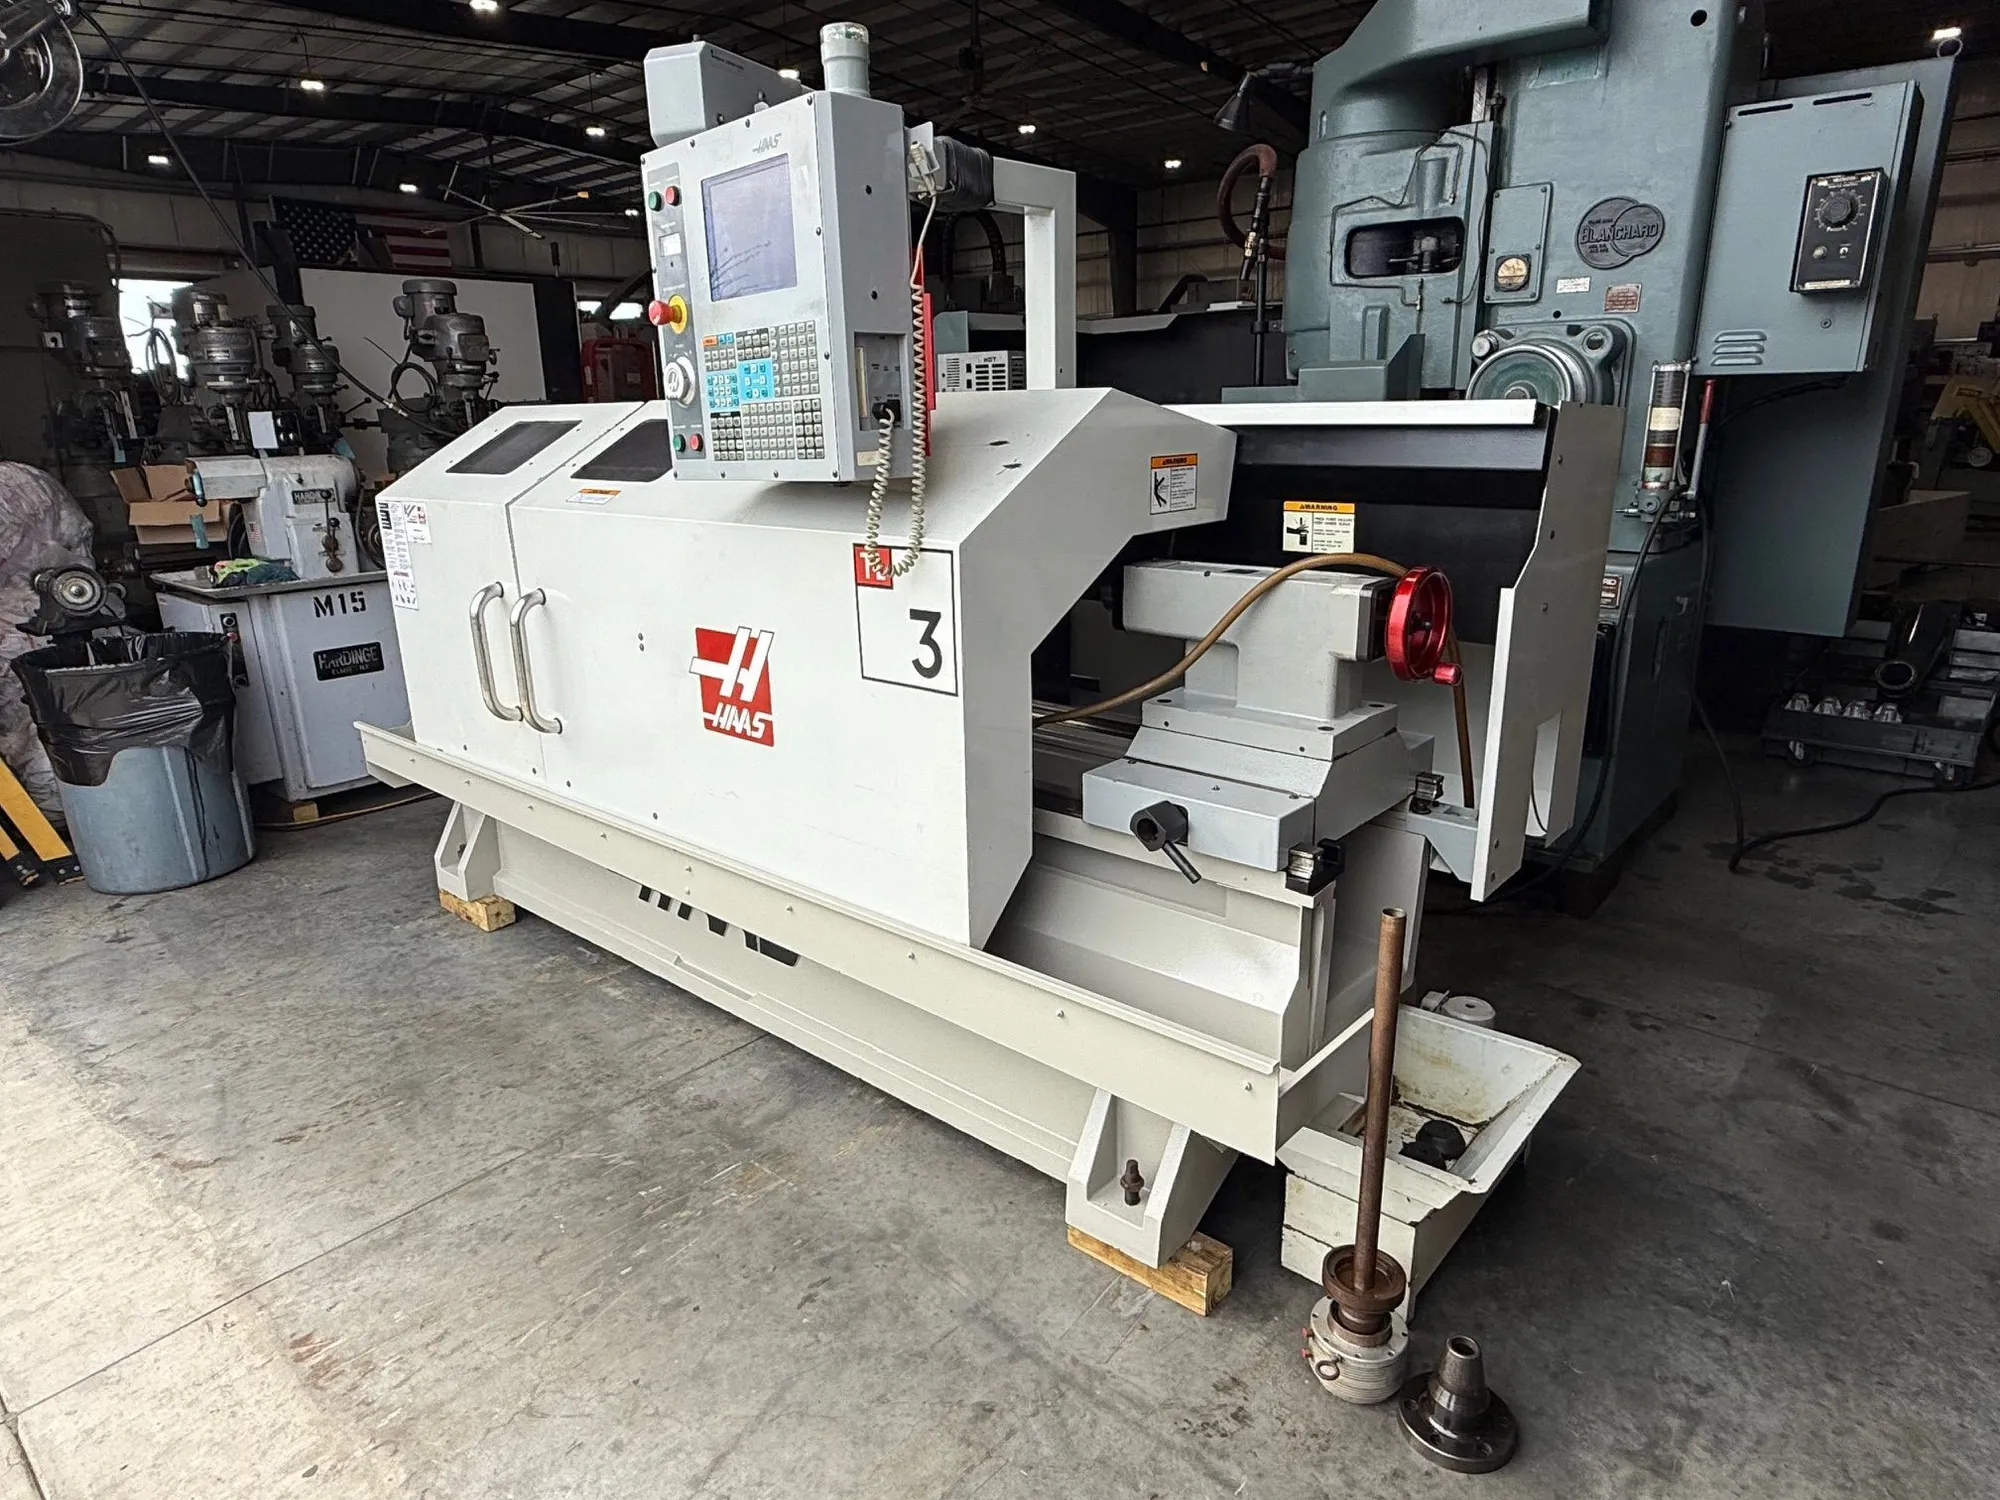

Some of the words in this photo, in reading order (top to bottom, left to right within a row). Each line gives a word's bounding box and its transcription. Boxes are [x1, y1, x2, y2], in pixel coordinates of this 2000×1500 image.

[1580, 224, 1658, 244] BLANCHARD
[313, 591, 366, 618] M15
[909, 608, 943, 679] 3
[702, 701, 773, 739] HAAS
